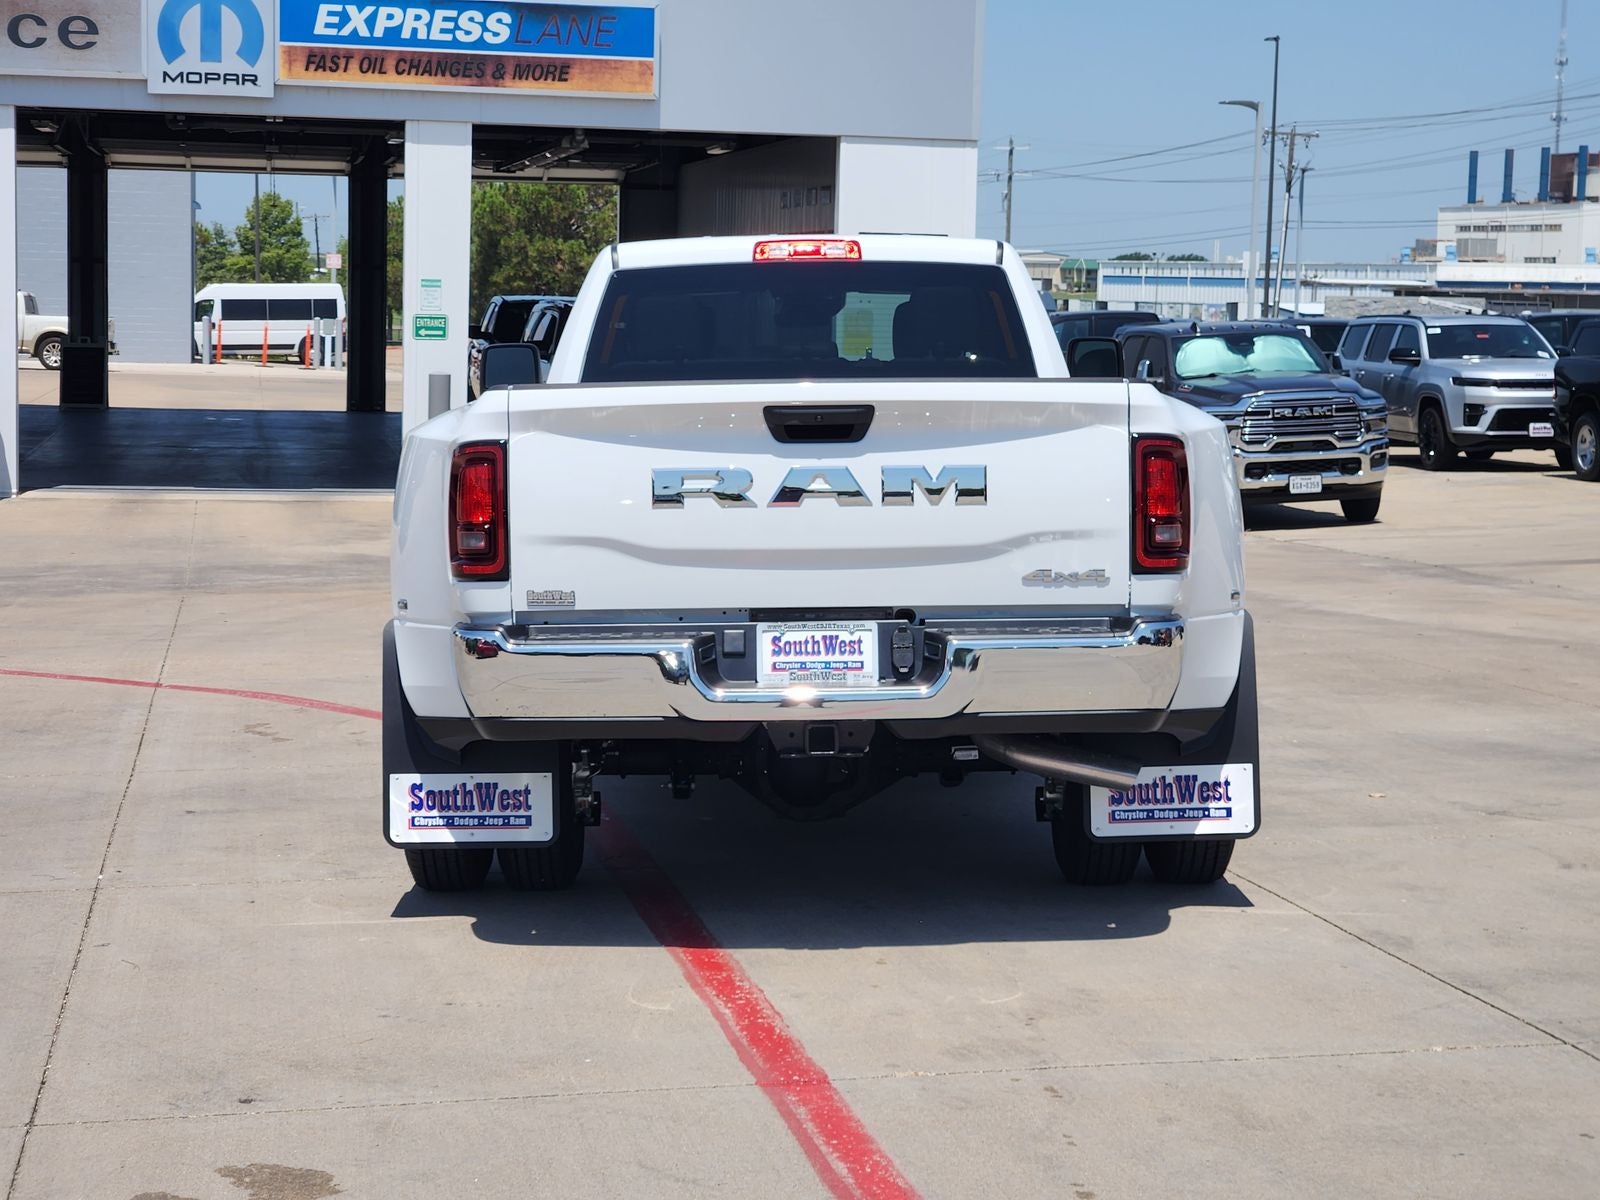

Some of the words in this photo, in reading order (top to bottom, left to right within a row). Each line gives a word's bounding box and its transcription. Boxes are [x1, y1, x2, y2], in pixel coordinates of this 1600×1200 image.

[7, 13, 99, 50] ce
[313, 3, 512, 45] EXPRESS
[513, 12, 617, 48] LANE
[304, 54, 353, 73] FAST
[358, 56, 387, 75] OIL
[395, 57, 485, 79] CHANGES
[491, 62, 506, 81] &
[512, 63, 571, 82] MORE
[162, 71, 259, 86] MOPAR
[416, 318, 445, 327] ENTRANCE
[1274, 406, 1332, 417] RAM
[651, 464, 987, 509] RAM
[770, 634, 864, 657] SouthWest
[775, 661, 801, 670] Chrysler
[806, 661, 826, 670] Dodge
[829, 660, 845, 670] Jeep
[847, 660, 862, 668] Ram
[789, 671, 847, 681] SouthWest
[408, 782, 532, 813] SouthWest
[414, 817, 447, 826] Chrysler
[453, 817, 479, 826] Dodge
[484, 817, 504, 826] Jeep
[509, 817, 526, 825] Ram
[1114, 810, 1147, 820] Chrysler
[1153, 808, 1179, 819] Dodge
[1183, 808, 1204, 818] Jeep
[1209, 808, 1227, 817] Ram
